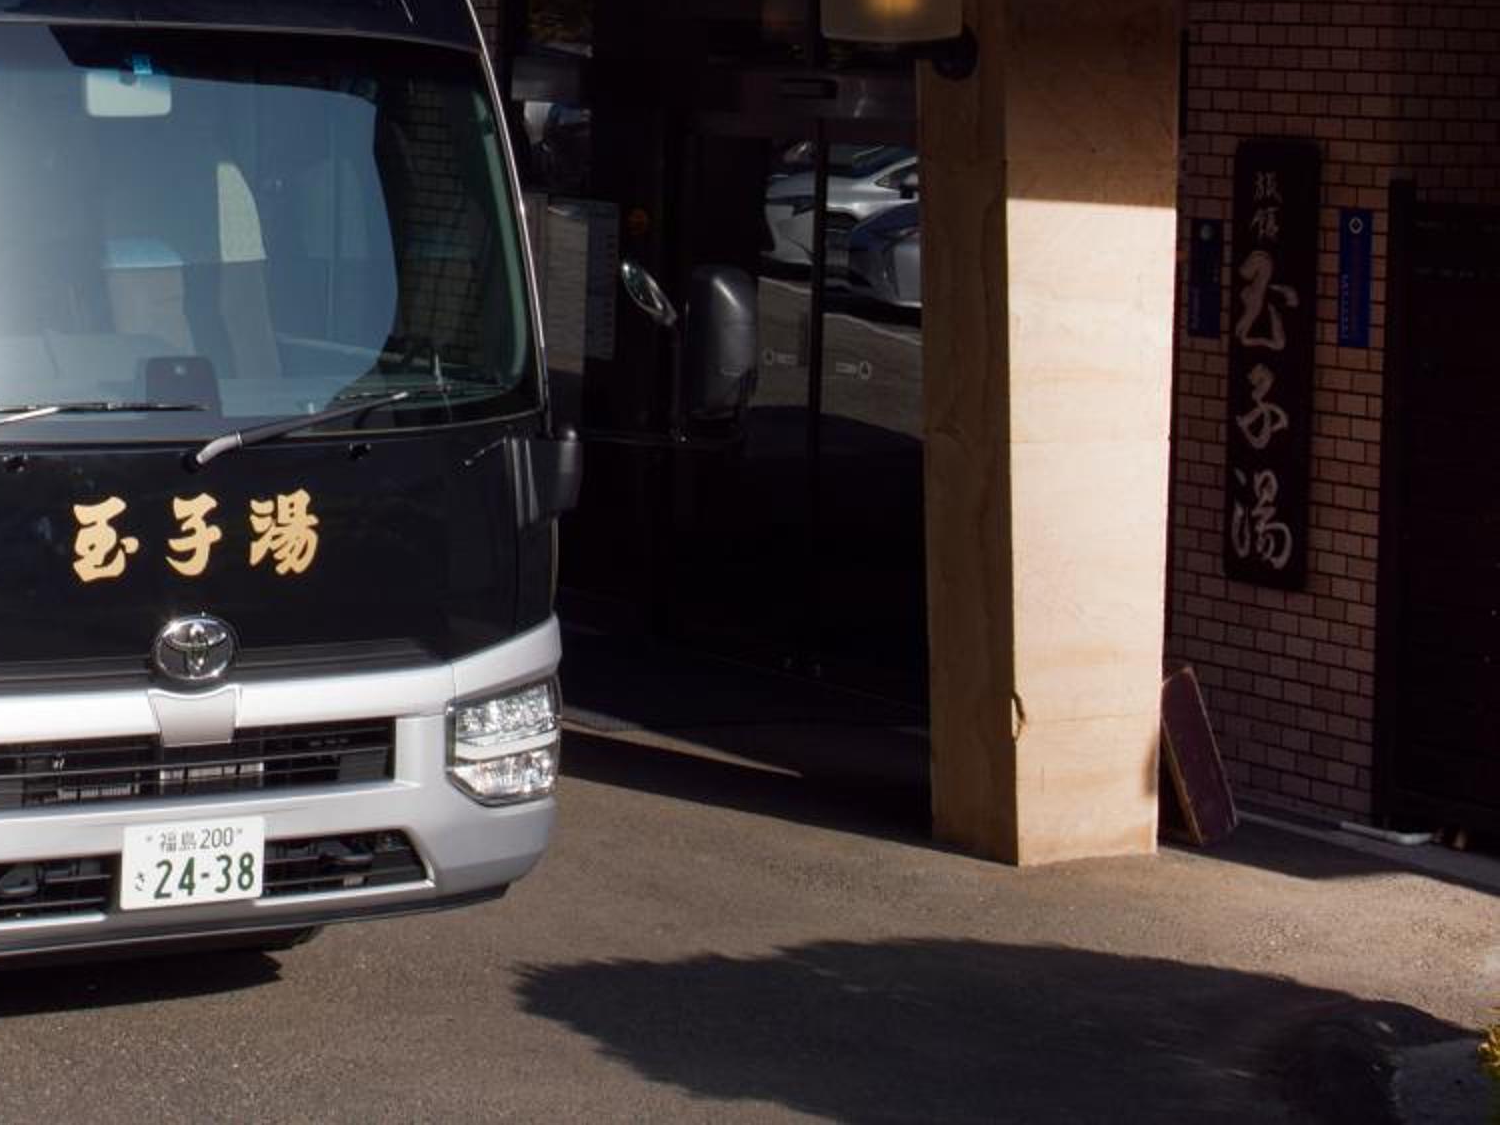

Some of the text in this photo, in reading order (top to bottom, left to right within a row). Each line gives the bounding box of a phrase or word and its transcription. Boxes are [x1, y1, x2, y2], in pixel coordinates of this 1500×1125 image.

[1234, 250, 1298, 570] 玉子湯
[73, 490, 320, 582] 玉子湯
[160, 827, 234, 852] 福島 200
[154, 852, 255, 899] 24-38
